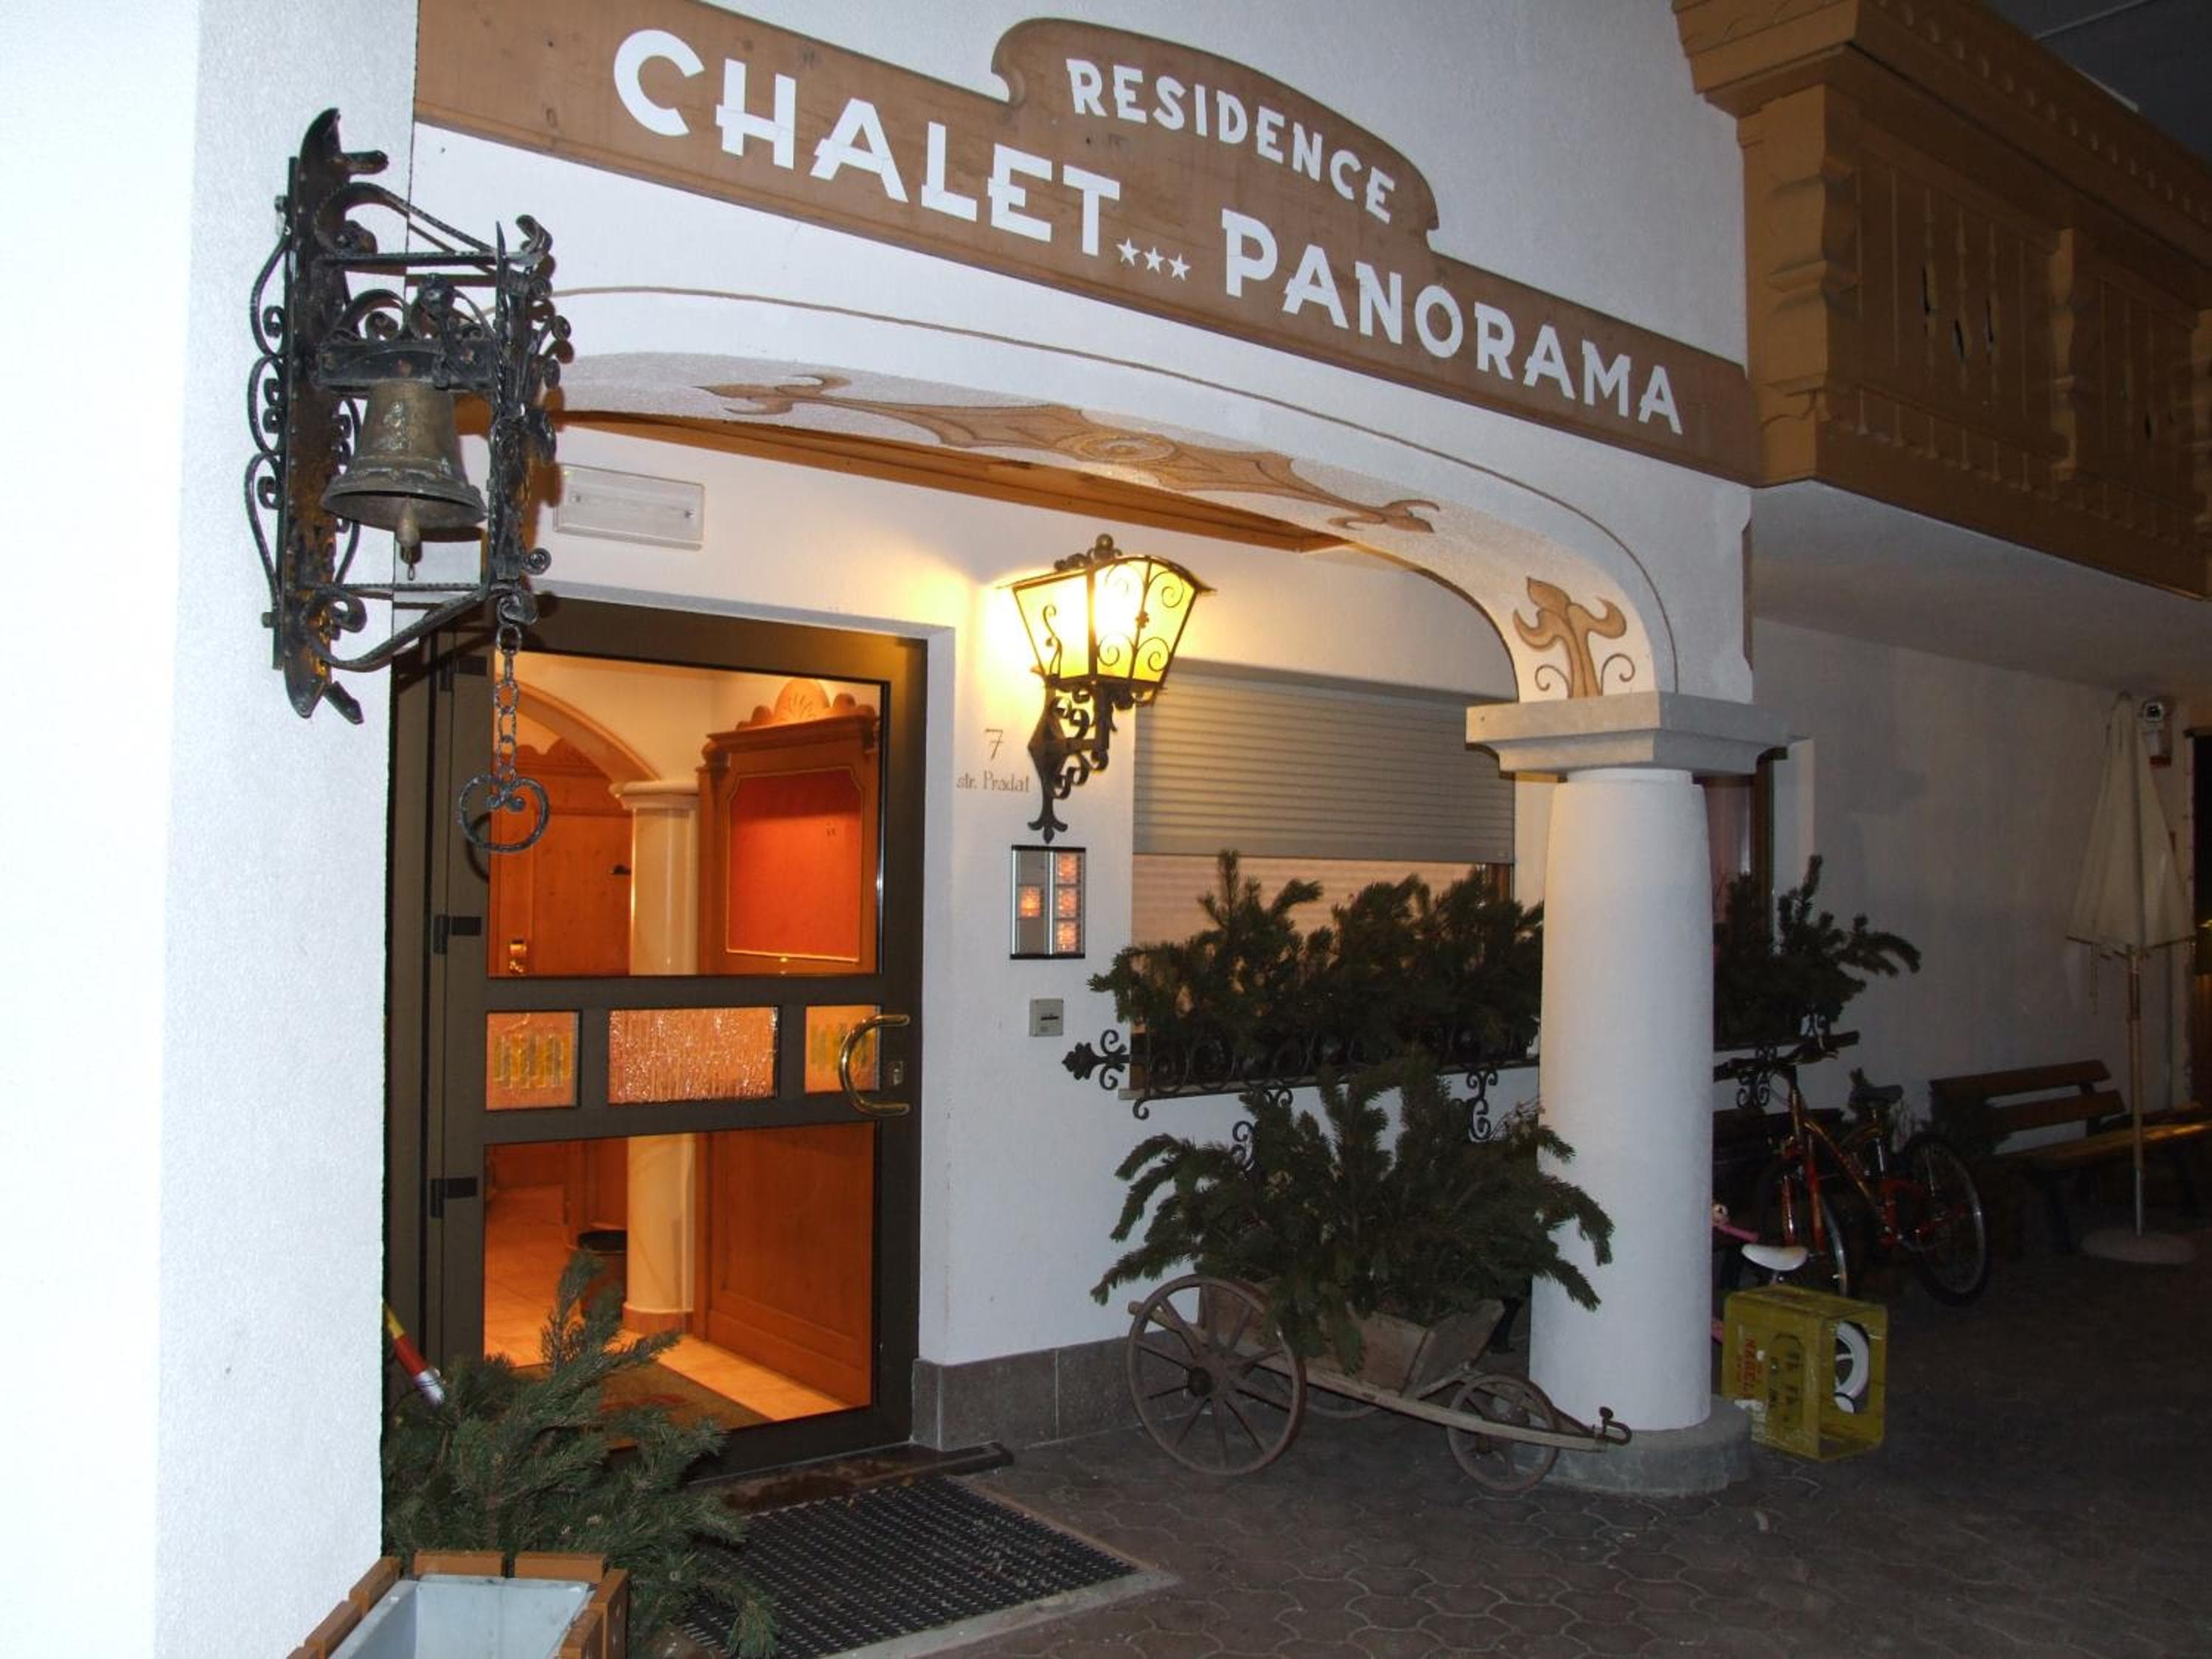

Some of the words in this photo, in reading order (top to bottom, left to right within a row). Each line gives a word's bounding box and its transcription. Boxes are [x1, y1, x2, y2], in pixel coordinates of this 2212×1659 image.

[1065, 58, 1395, 223] RESIDENCE
[613, 29, 1120, 257] CHALET
[1222, 208, 1683, 435] PANORAMA
[956, 772, 978, 790] str.
[984, 728, 1003, 761] 7
